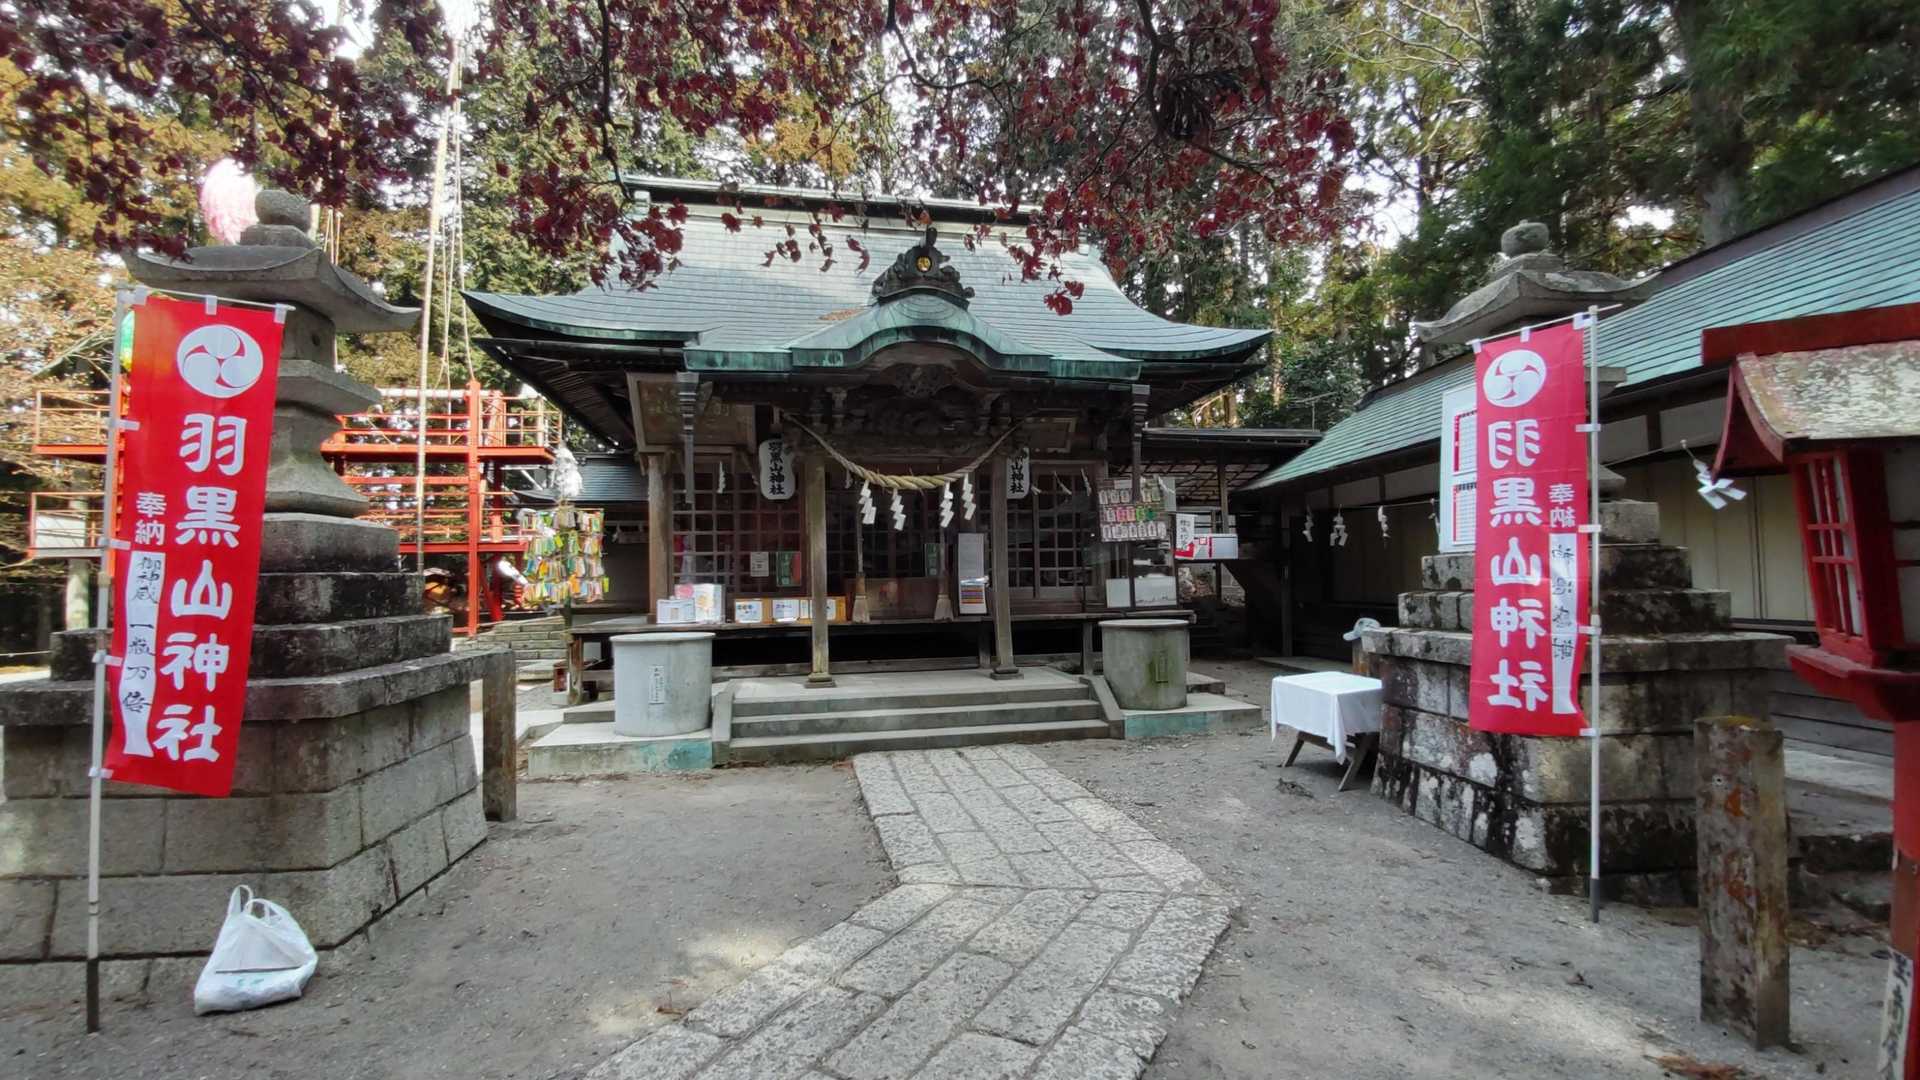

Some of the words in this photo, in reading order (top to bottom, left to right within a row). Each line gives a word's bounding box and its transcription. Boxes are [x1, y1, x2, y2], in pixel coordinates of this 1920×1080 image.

[134, 491, 168, 546] 奉納
[153, 413, 247, 762] 羽黒山神社
